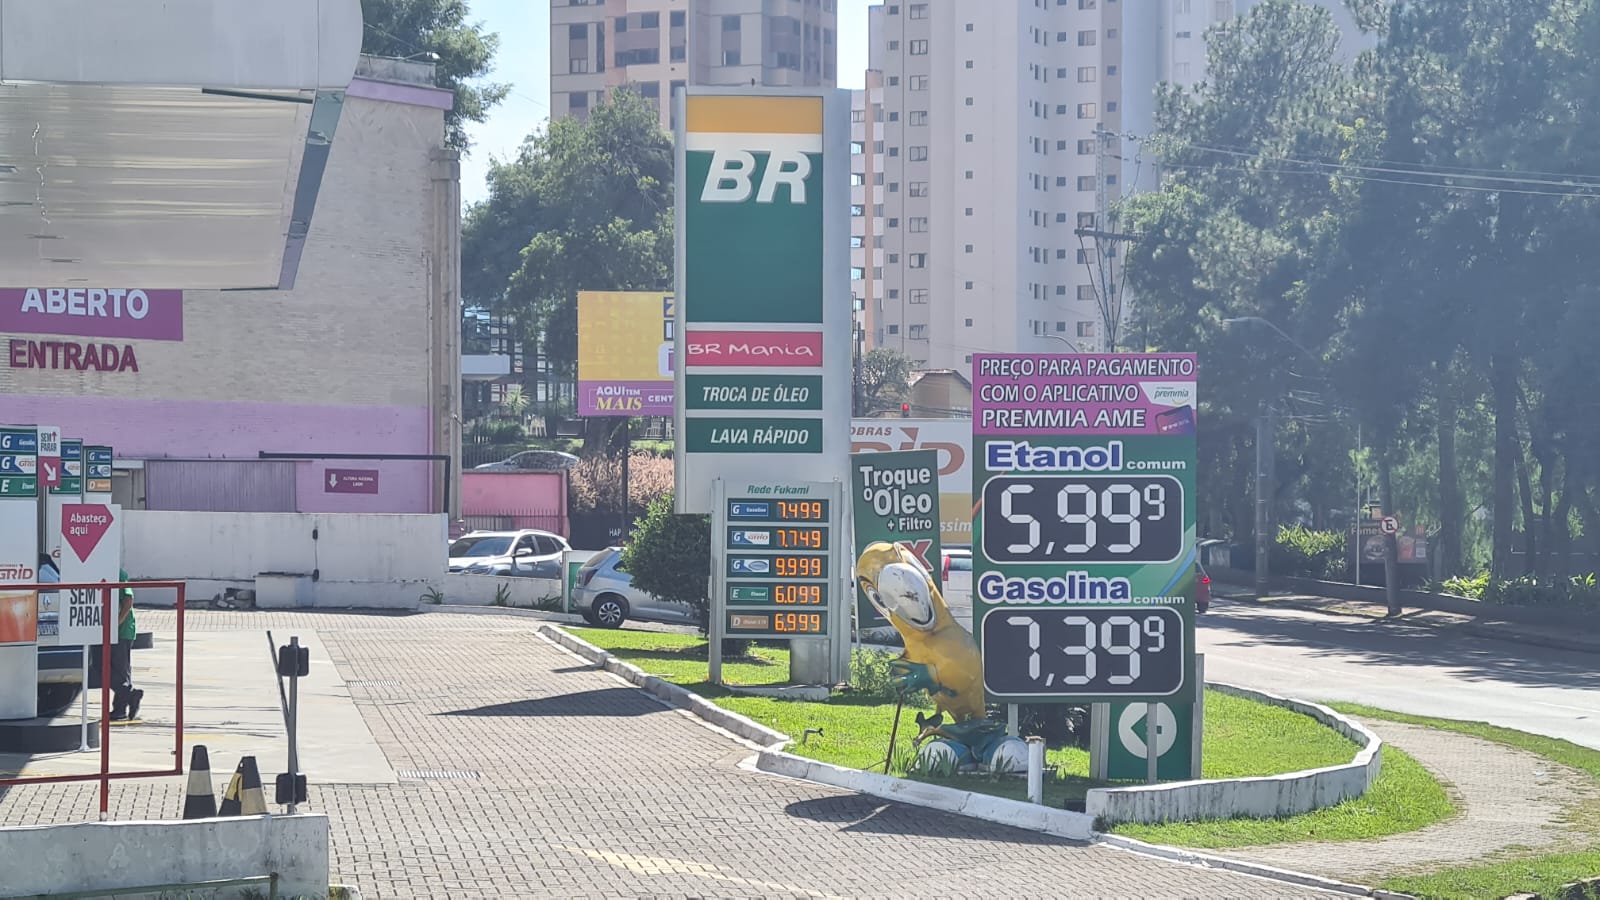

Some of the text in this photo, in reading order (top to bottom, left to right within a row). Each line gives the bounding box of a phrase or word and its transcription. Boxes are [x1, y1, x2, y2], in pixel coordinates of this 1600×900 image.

[700, 150, 811, 204] BR
[21, 288, 149, 320] ABERTO
[9, 340, 139, 373] ENTRADA
[688, 343, 813, 357] BR Mania
[980, 358, 1193, 380] PREÇO PARA PAGAMENTO
[596, 386, 625, 396] AQUI
[648, 395, 674, 403] CENT
[703, 384, 809, 402] TROCA DE ÓLEO
[980, 384, 1139, 402] COM O APLICATIVO
[1154, 388, 1189, 399] premmia
[595, 396, 643, 411] MAIS
[981, 409, 1088, 428] PREMMIA
[1094, 409, 1147, 428] AME
[711, 426, 809, 444] LAVA RÁPIDO
[985, 441, 1186, 470] Etanol comum
[859, 465, 931, 490] Troque
[747, 485, 809, 495] Rede Fukami
[777, 501, 821, 519] 7.499
[873, 486, 932, 516] Óleo
[70, 513, 107, 525] Abasteça
[898, 517, 932, 531] Filtro
[70, 525, 88, 536] aqui
[777, 530, 821, 548] 7.749
[776, 558, 821, 576] 9.999
[70, 587, 95, 605] SEM
[775, 586, 820, 603] 6.099
[979, 571, 1185, 605] Gasolina comum
[69, 606, 104, 627] PARA
[775, 613, 820, 631] 6.999
